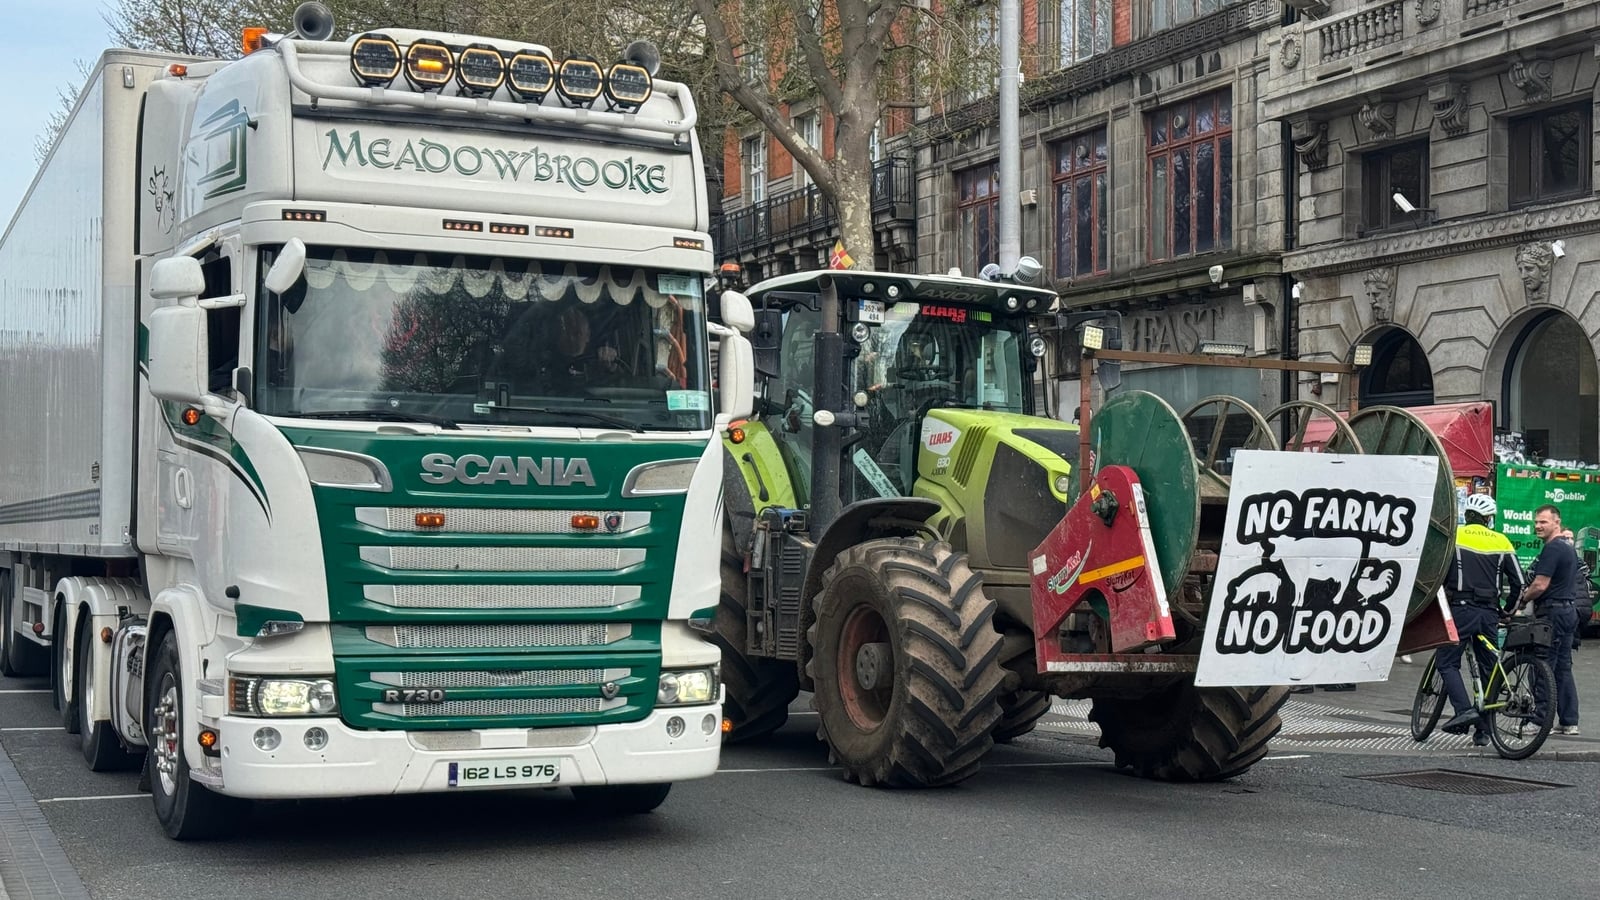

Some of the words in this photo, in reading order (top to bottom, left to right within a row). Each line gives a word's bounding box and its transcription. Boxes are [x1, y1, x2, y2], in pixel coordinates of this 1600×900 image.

[922, 305, 966, 320] CLAAS
[929, 431, 953, 446] CLAAS
[419, 453, 596, 486] SCANIA
[1244, 499, 1293, 536] NO
[1304, 497, 1409, 538] FARMS
[1503, 509, 1533, 520] World
[1503, 524, 1531, 535] Rated
[1223, 610, 1279, 646] NO
[1290, 609, 1384, 646] FOOD
[385, 689, 399, 702] R
[402, 689, 444, 702] 730
[463, 766, 489, 780] 162
[494, 765, 516, 779] LS
[521, 764, 555, 778] 976
